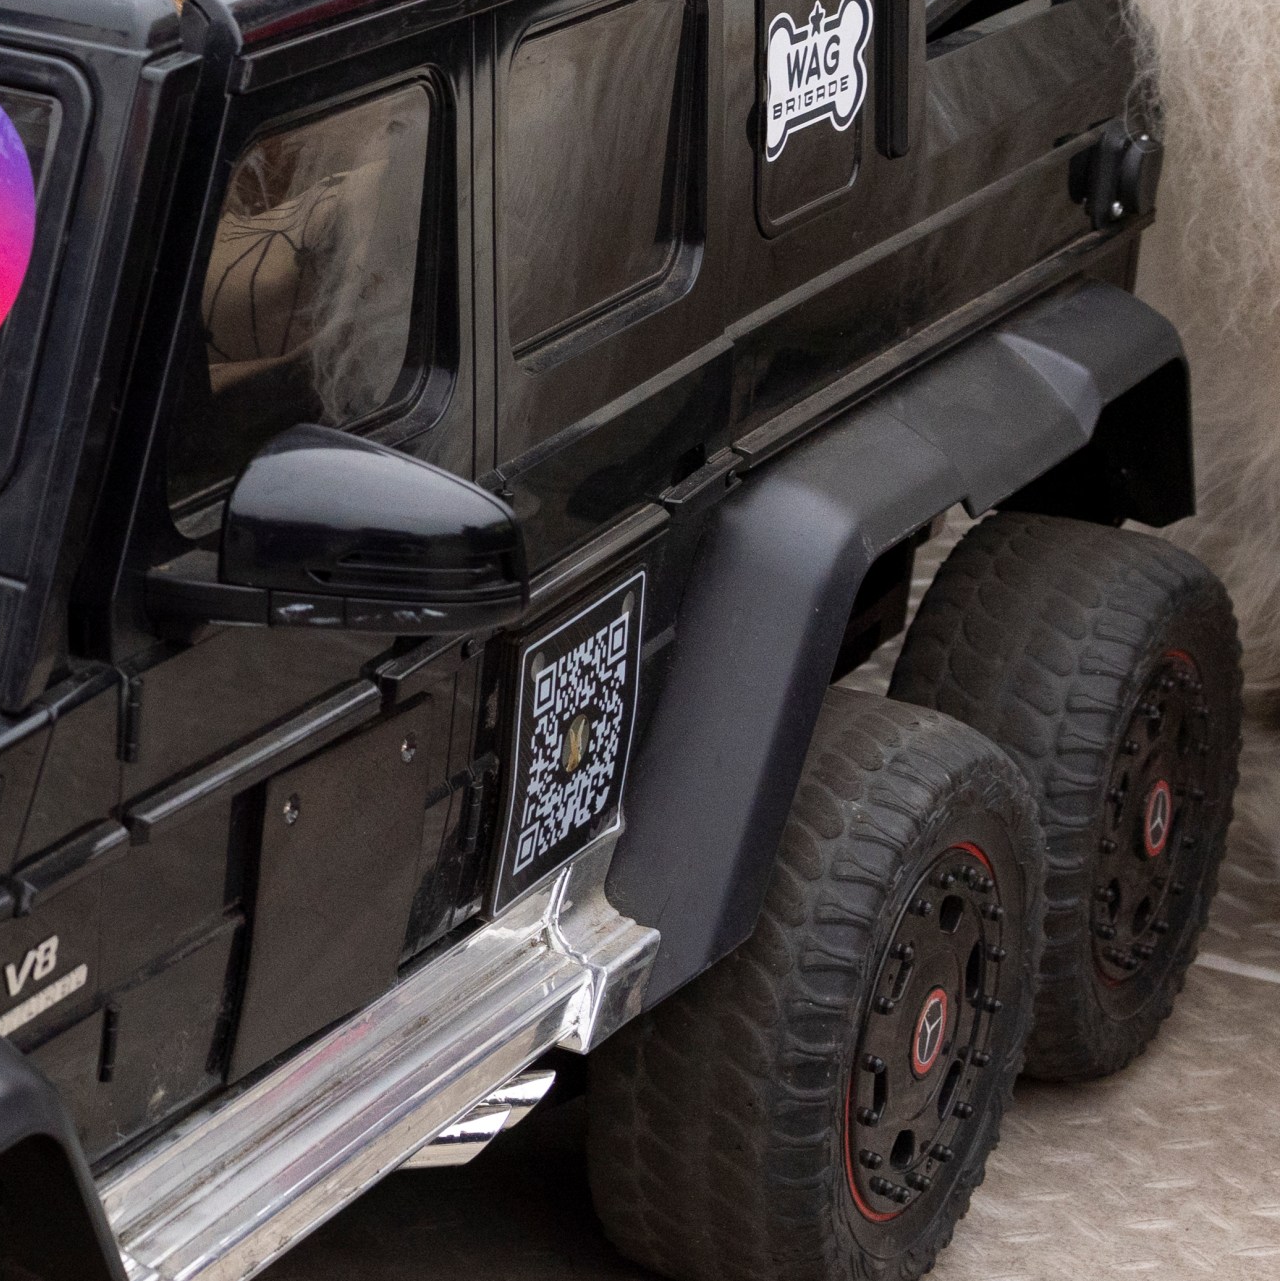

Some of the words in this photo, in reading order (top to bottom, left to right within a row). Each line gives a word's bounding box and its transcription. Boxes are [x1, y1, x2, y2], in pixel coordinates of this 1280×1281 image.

[786, 34, 841, 92] WAG
[772, 74, 849, 120] BRIGADE
[5, 934, 59, 998] V8
